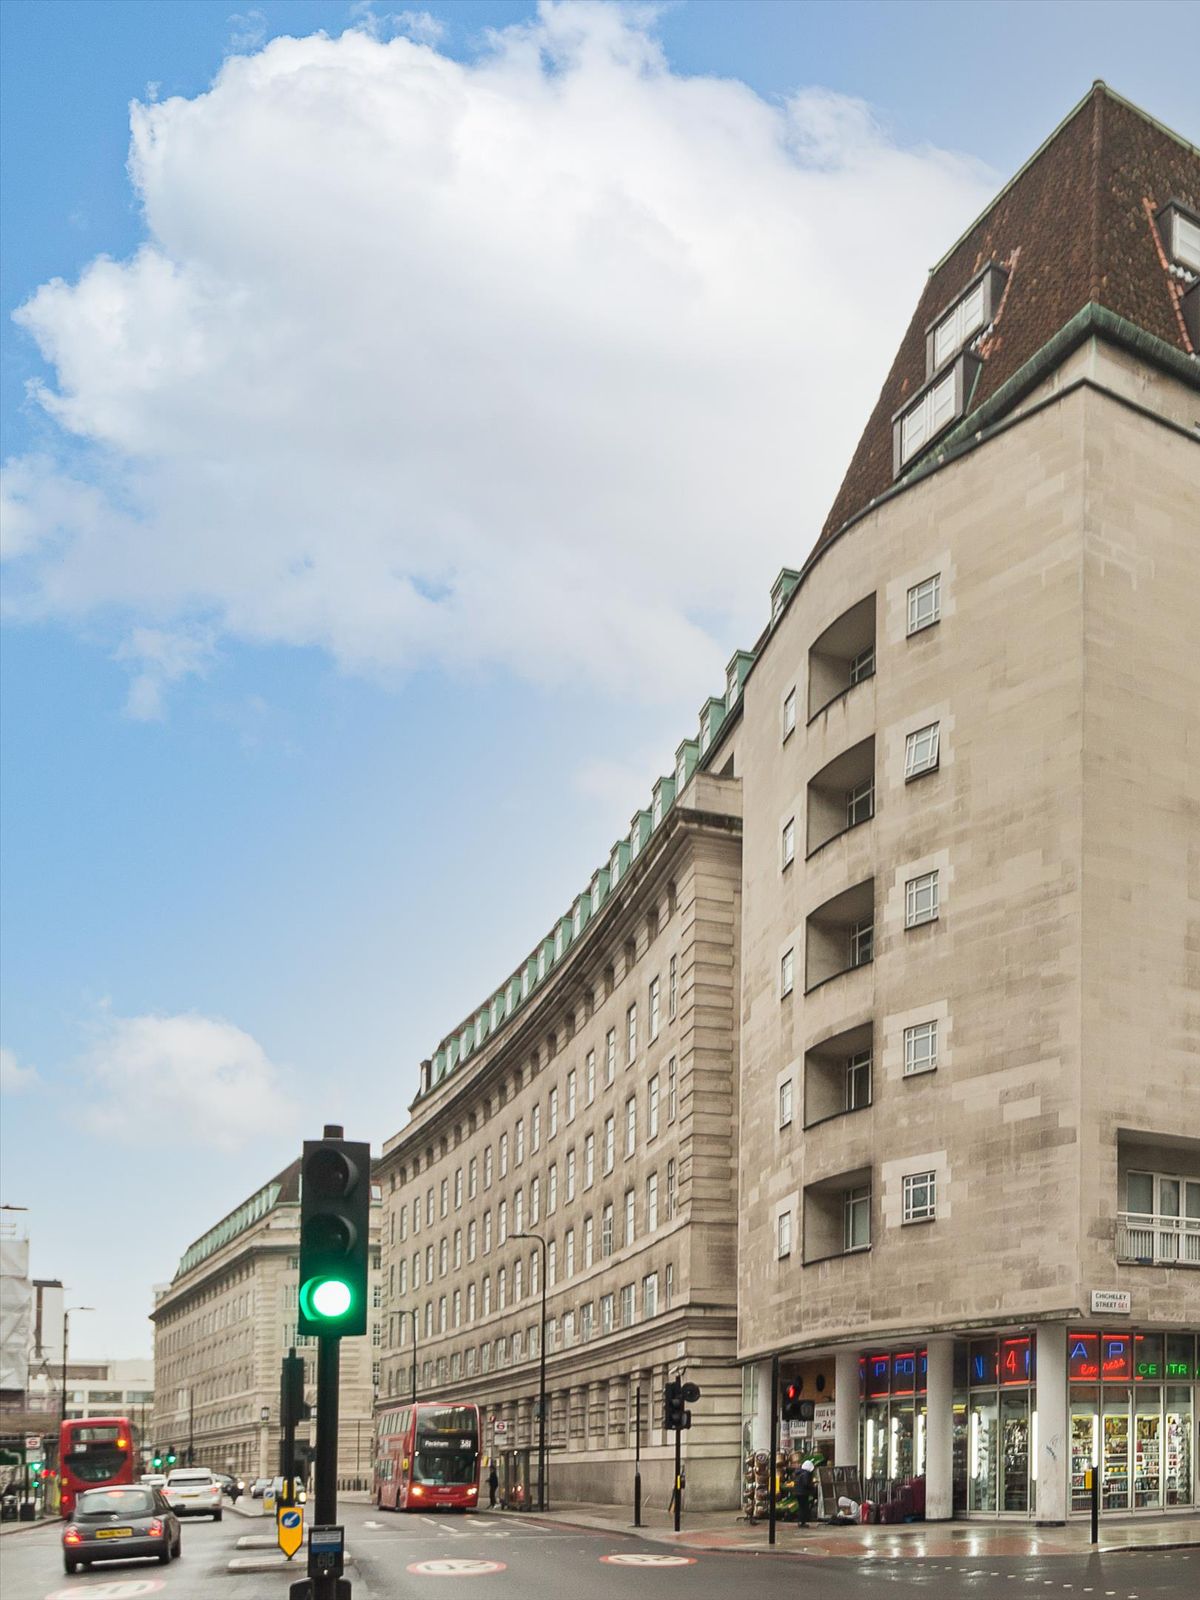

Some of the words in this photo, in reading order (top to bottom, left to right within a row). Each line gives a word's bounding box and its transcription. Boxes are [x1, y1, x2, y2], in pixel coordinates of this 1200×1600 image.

[1095, 1292, 1127, 1301] CHICHELEY
[1071, 1342, 1088, 1359] A
[1109, 1342, 1124, 1358] P
[822, 1420, 832, 1432] 24
